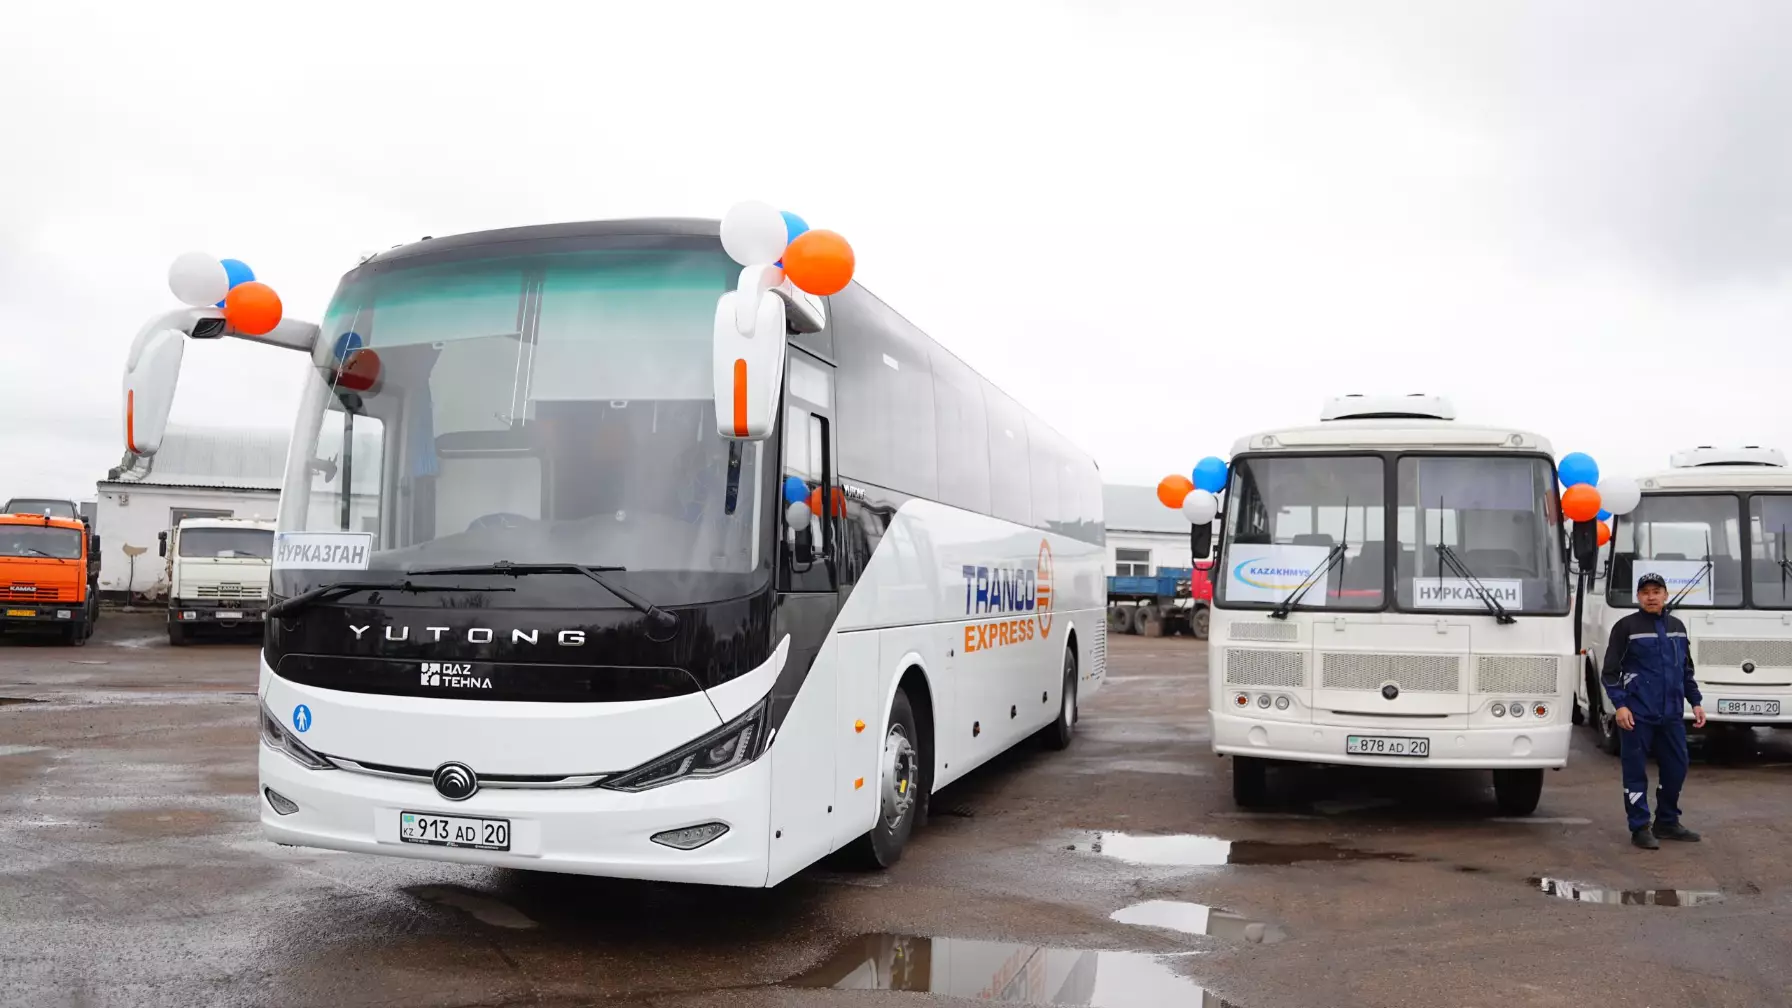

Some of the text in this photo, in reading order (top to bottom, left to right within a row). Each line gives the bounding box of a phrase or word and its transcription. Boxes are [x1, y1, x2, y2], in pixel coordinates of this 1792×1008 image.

[277, 544, 365, 564] НУРКАЗГАН
[1250, 567, 1311, 577] KAZAKHMYS
[962, 565, 1035, 615] TRANCO
[349, 624, 586, 646] YUTONG
[964, 618, 1035, 653] EXPRESS
[442, 663, 472, 675] QAZ
[442, 676, 493, 689] TEHNA
[1728, 702, 1778, 712] 881 AD 20
[1360, 739, 1427, 754] 878 AD 20
[403, 827, 414, 836] KZ
[418, 818, 506, 844] 913 AD 20
